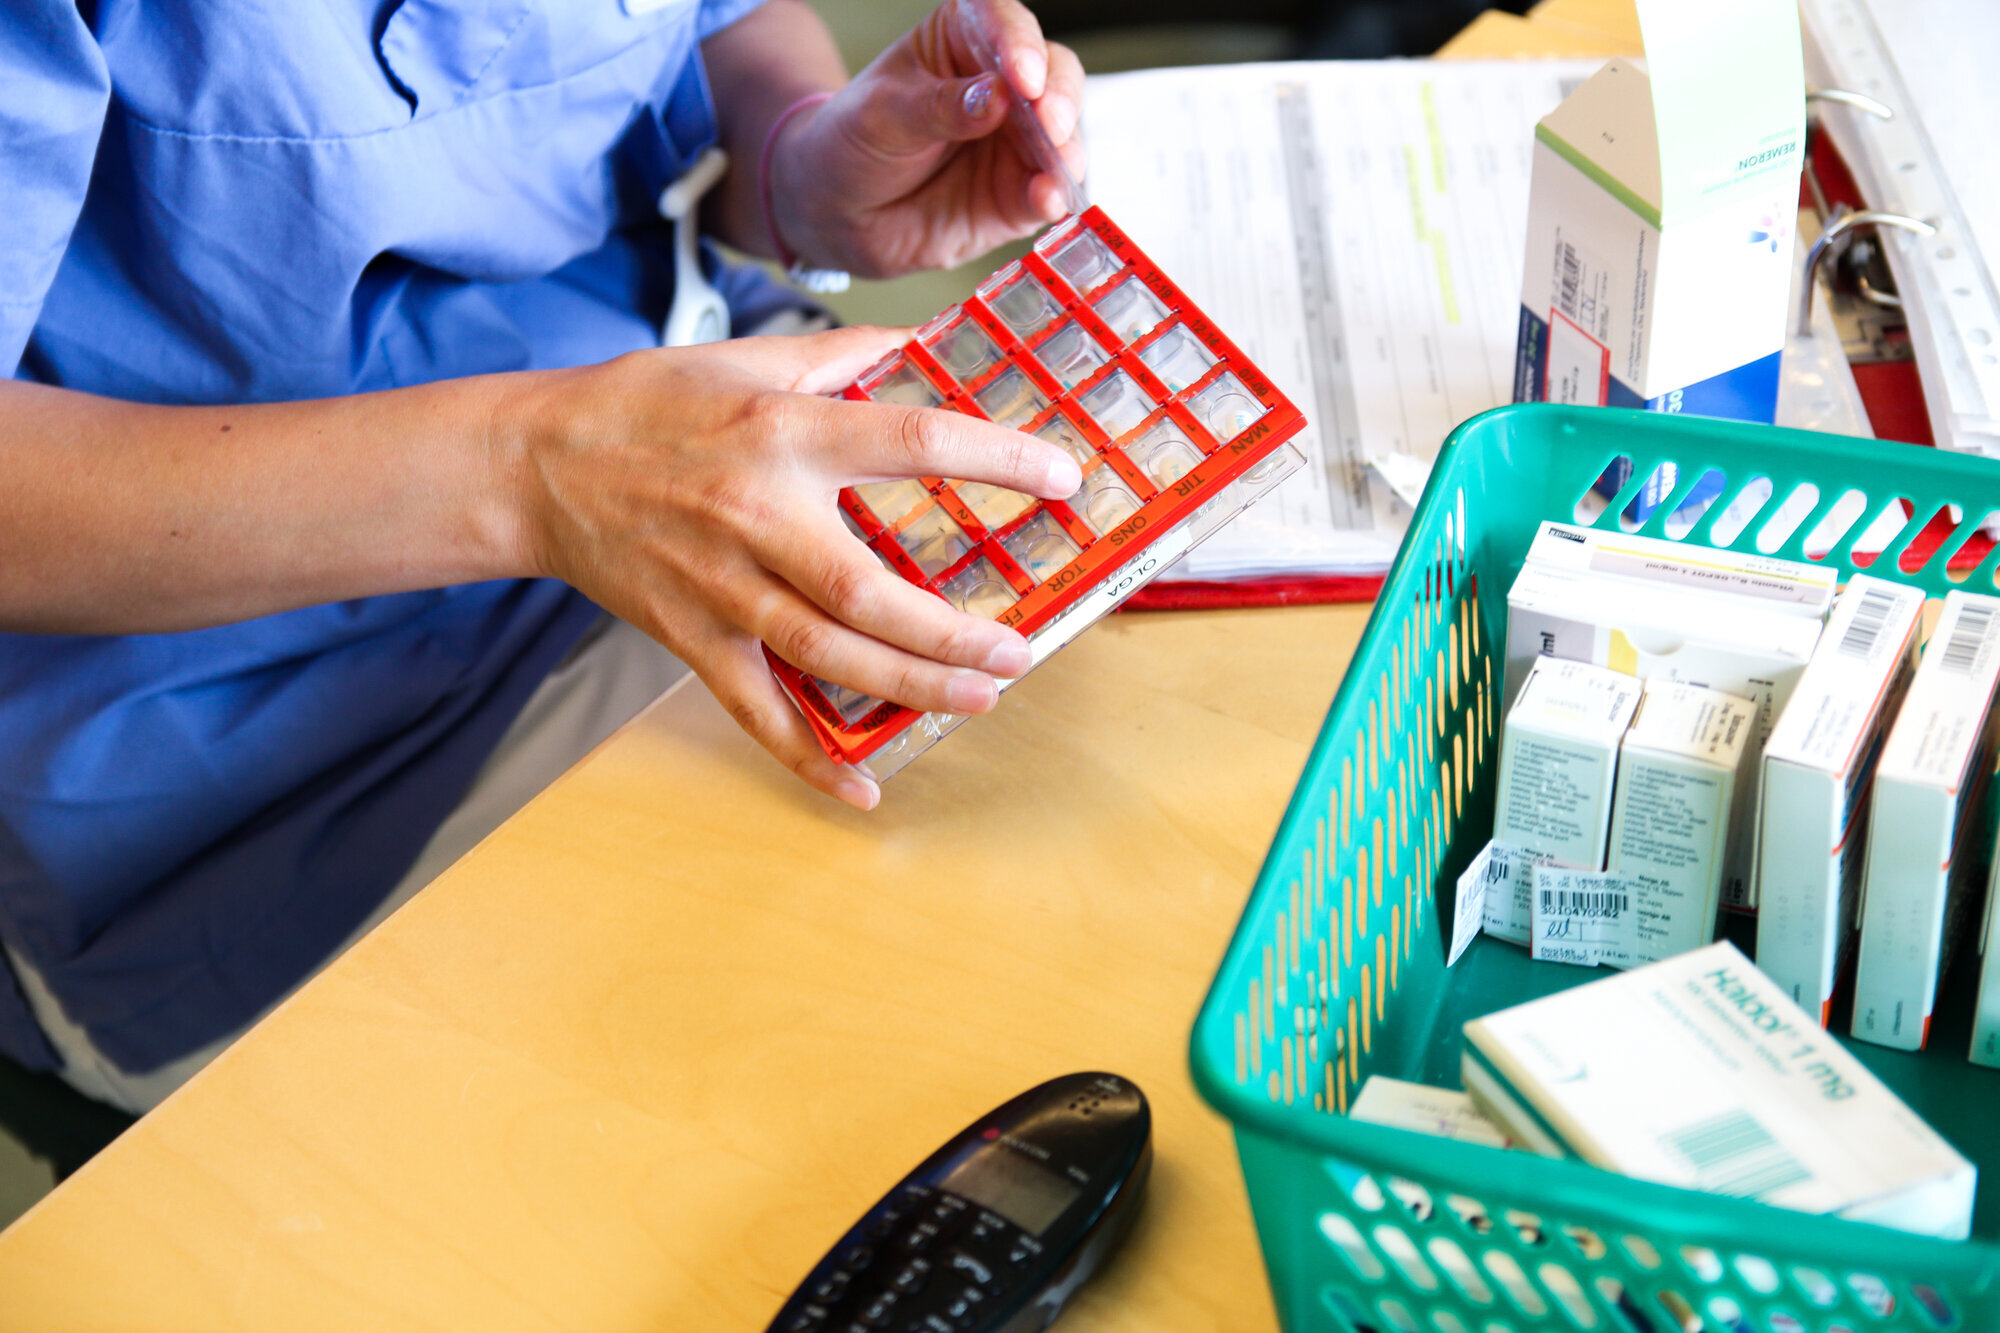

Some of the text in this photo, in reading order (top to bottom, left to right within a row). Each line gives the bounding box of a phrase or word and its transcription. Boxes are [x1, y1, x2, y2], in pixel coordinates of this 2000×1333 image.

[1738, 141, 1797, 171] REMERON
[1095, 222, 1125, 250] 21-24
[1144, 271, 1173, 299] 17-19
[1191, 319, 1221, 347] 12-14
[1237, 368, 1269, 397] 07-09
[1230, 422, 1270, 455] MAN
[1173, 474, 1206, 497] TIR
[1110, 516, 1147, 546] ONS
[1047, 563, 1087, 593] TOR
[1107, 558, 1157, 597] OLGA
[1645, 561, 1679, 575] mg/ml
[1691, 569, 1730, 583] DEPOT
[1751, 578, 1795, 593] Vitamin
[1000, 609, 1024, 628] FR
[862, 701, 901, 732] SØN
[1703, 968, 1793, 1035] Haldol
[1790, 1044, 1816, 1060] 1
[1803, 1061, 1856, 1102] mg
